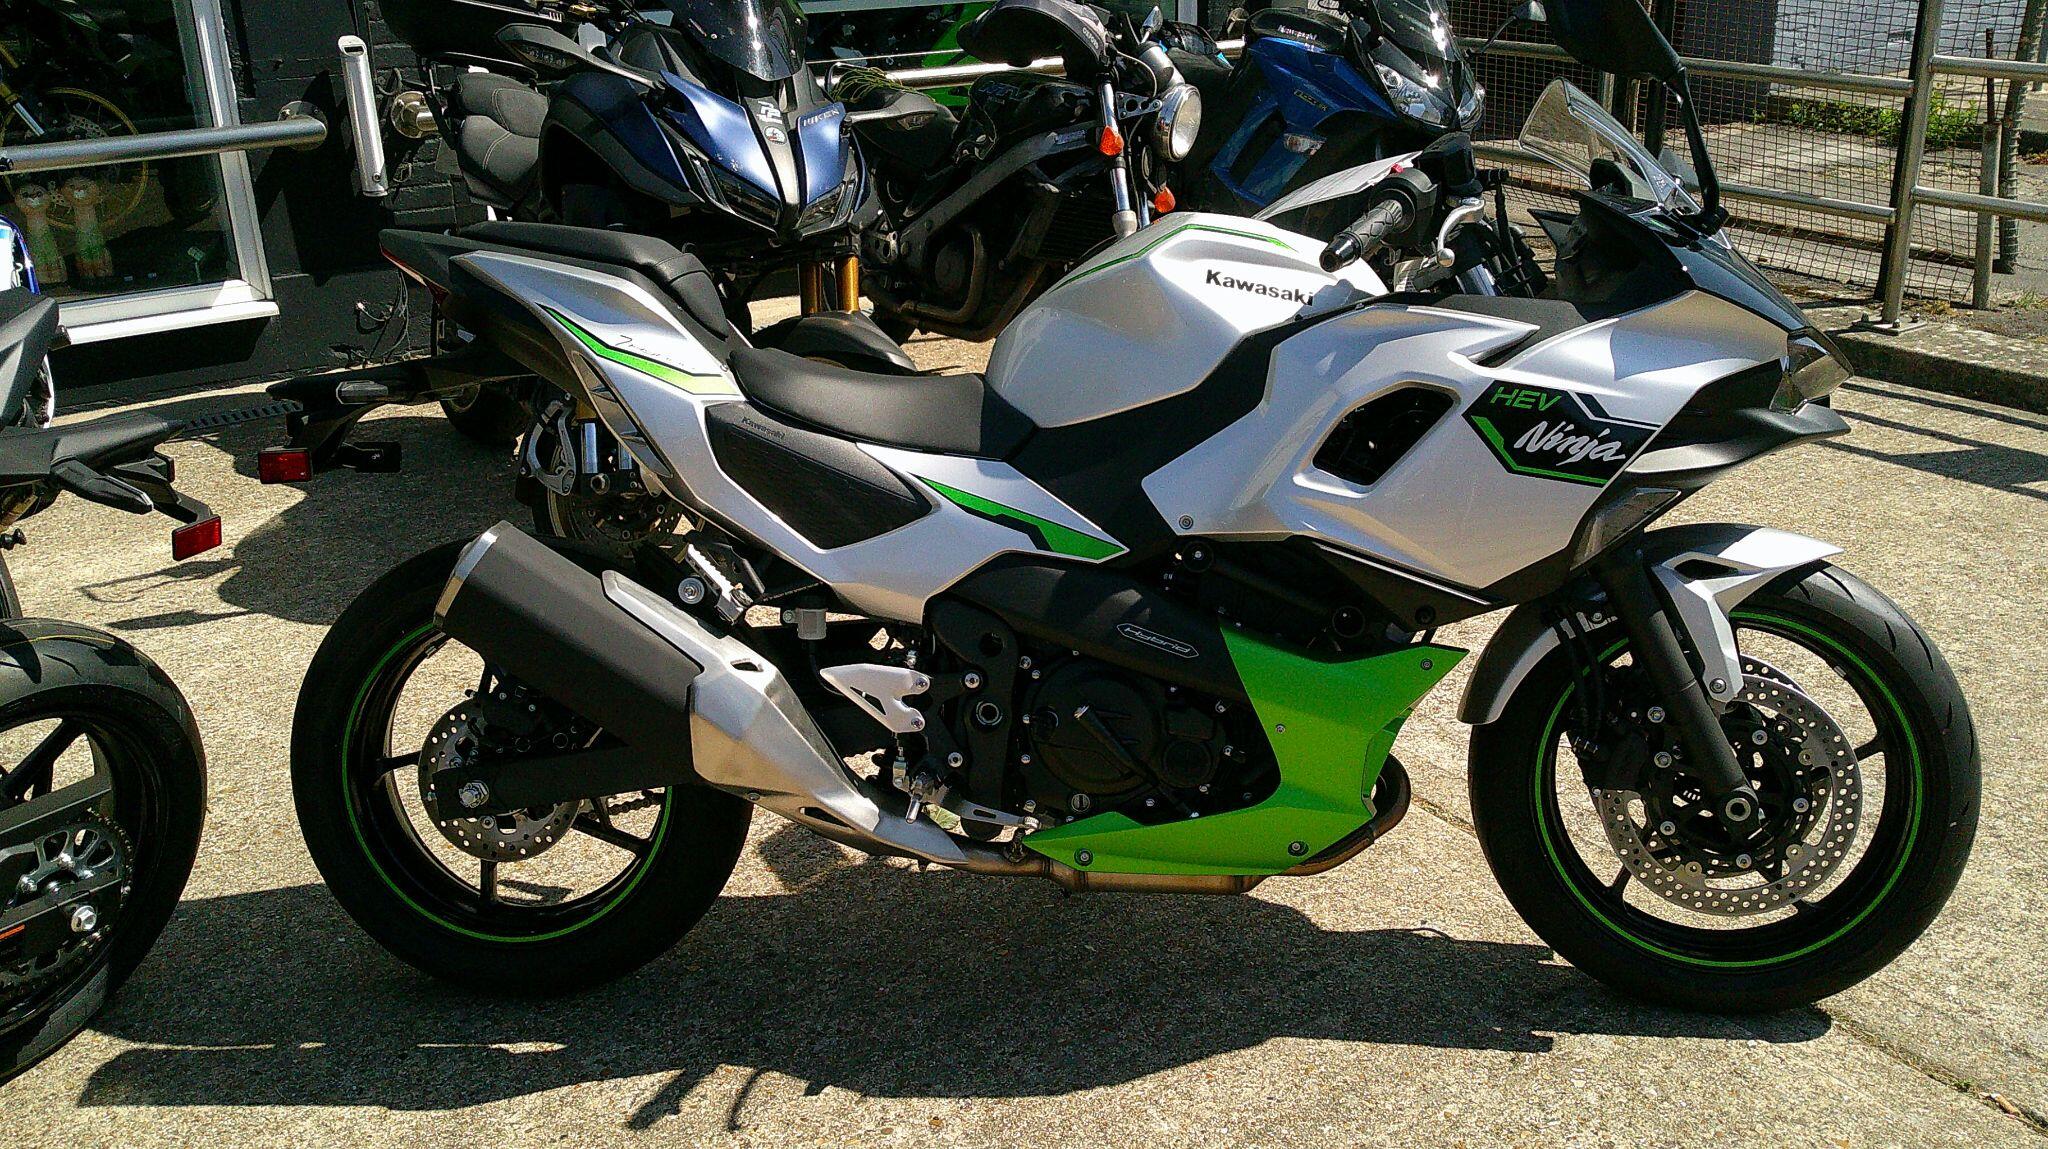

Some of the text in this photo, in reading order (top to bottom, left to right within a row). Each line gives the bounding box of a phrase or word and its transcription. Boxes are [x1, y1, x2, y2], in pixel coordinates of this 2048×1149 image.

[1205, 269, 1314, 307] Kawasaki
[1490, 386, 1562, 411] HEV
[1513, 420, 1626, 467] Ninja
[1123, 627, 1192, 653] Hybrid
